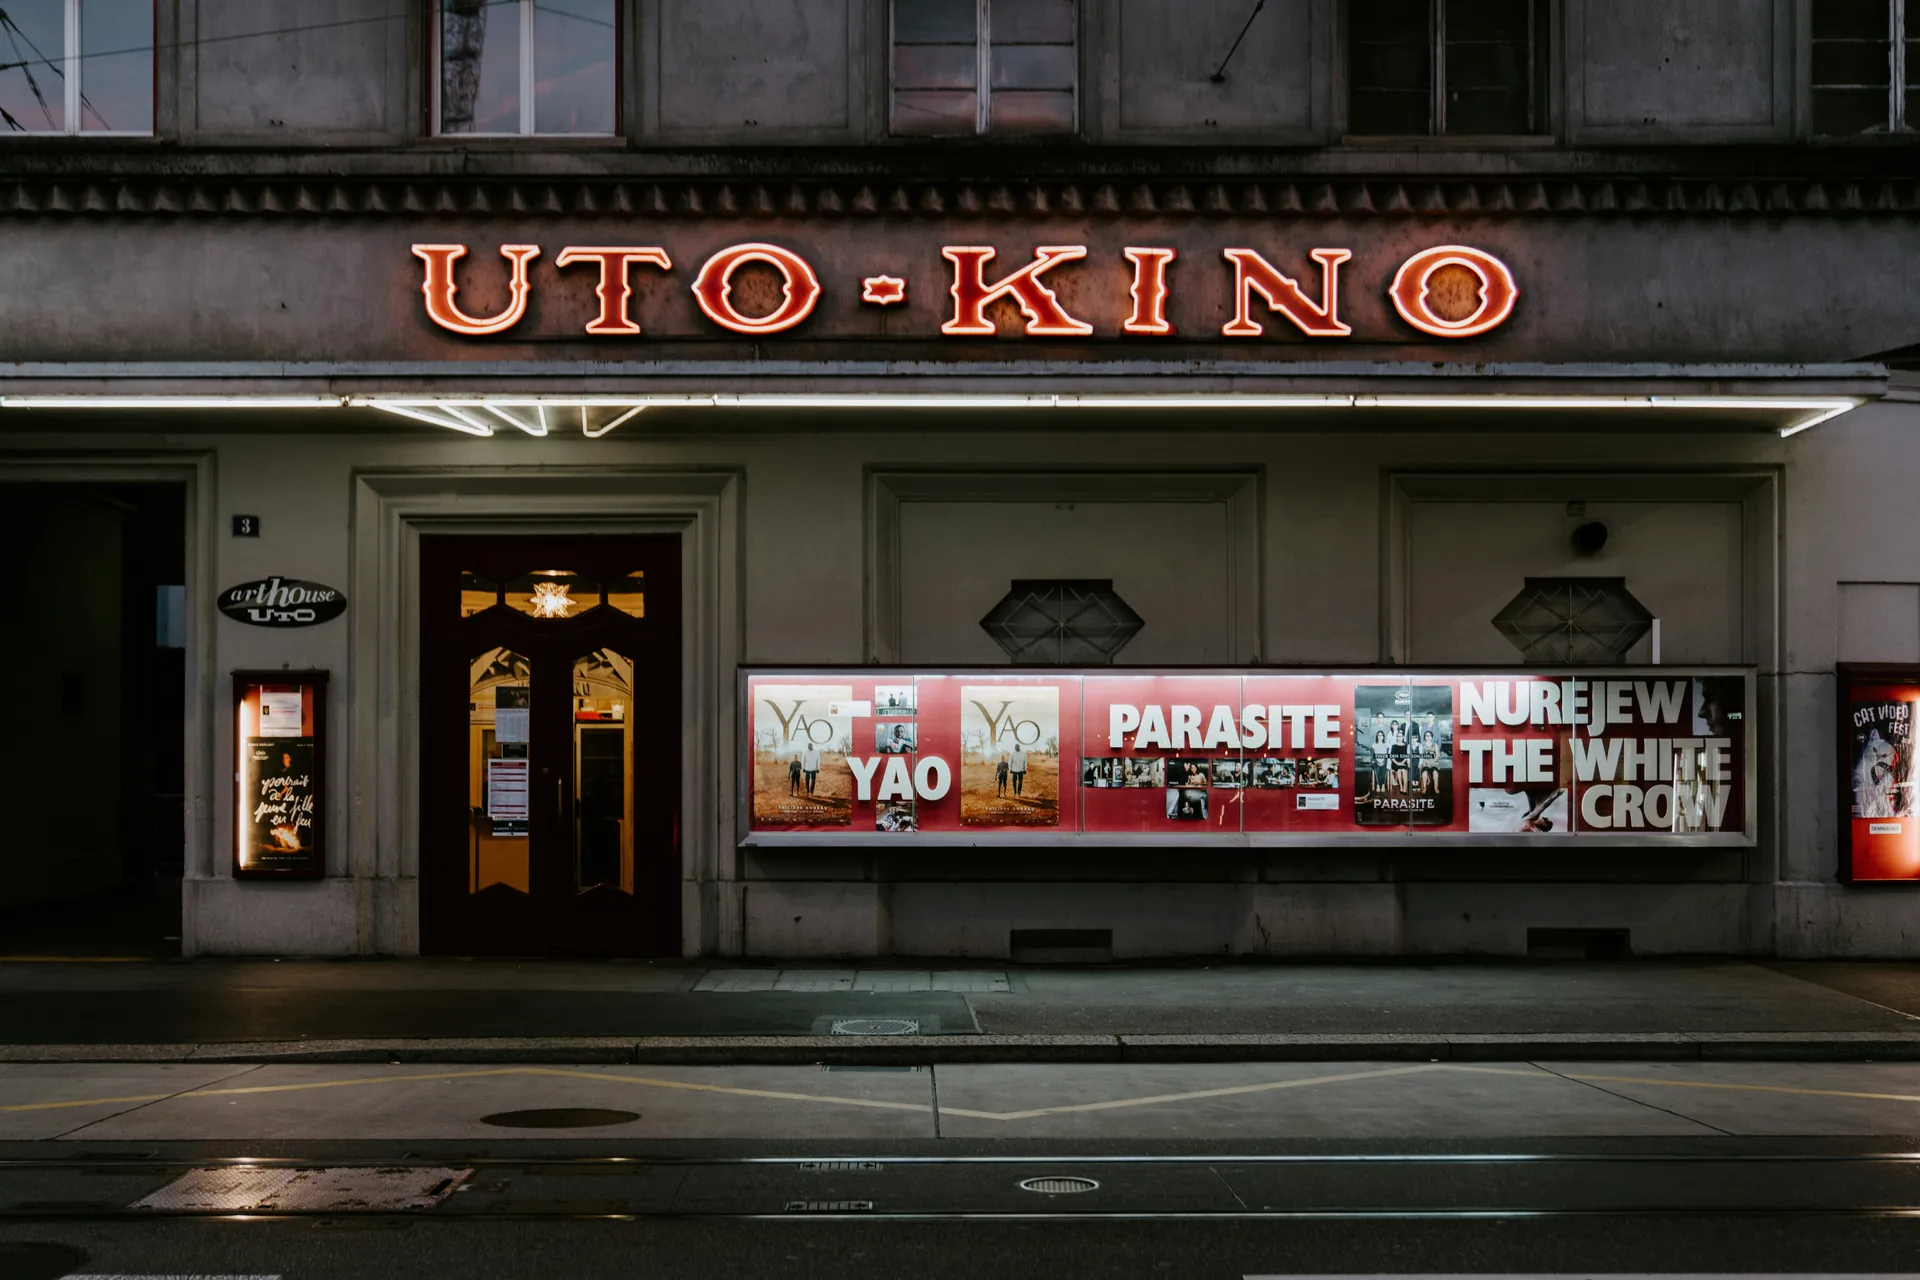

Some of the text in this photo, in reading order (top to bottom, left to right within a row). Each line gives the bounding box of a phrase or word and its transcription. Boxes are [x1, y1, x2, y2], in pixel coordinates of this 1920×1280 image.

[242, 518, 250, 534] 3
[230, 578, 336, 608] arthouse
[247, 608, 316, 622] UTO
[762, 699, 834, 745] YAO
[969, 700, 1041, 746] YAO
[1109, 704, 1341, 750] PARASITE
[1459, 680, 1687, 737] NUREJEW
[1853, 704, 1909, 728] CAT VIDEO
[1888, 721, 1910, 736] FEST
[845, 756, 951, 801] YAO
[1459, 737, 1732, 783] THE WHITE
[261, 774, 310, 796] portrait
[1373, 798, 1435, 809] PARASITE
[1580, 784, 1732, 829] CROW
